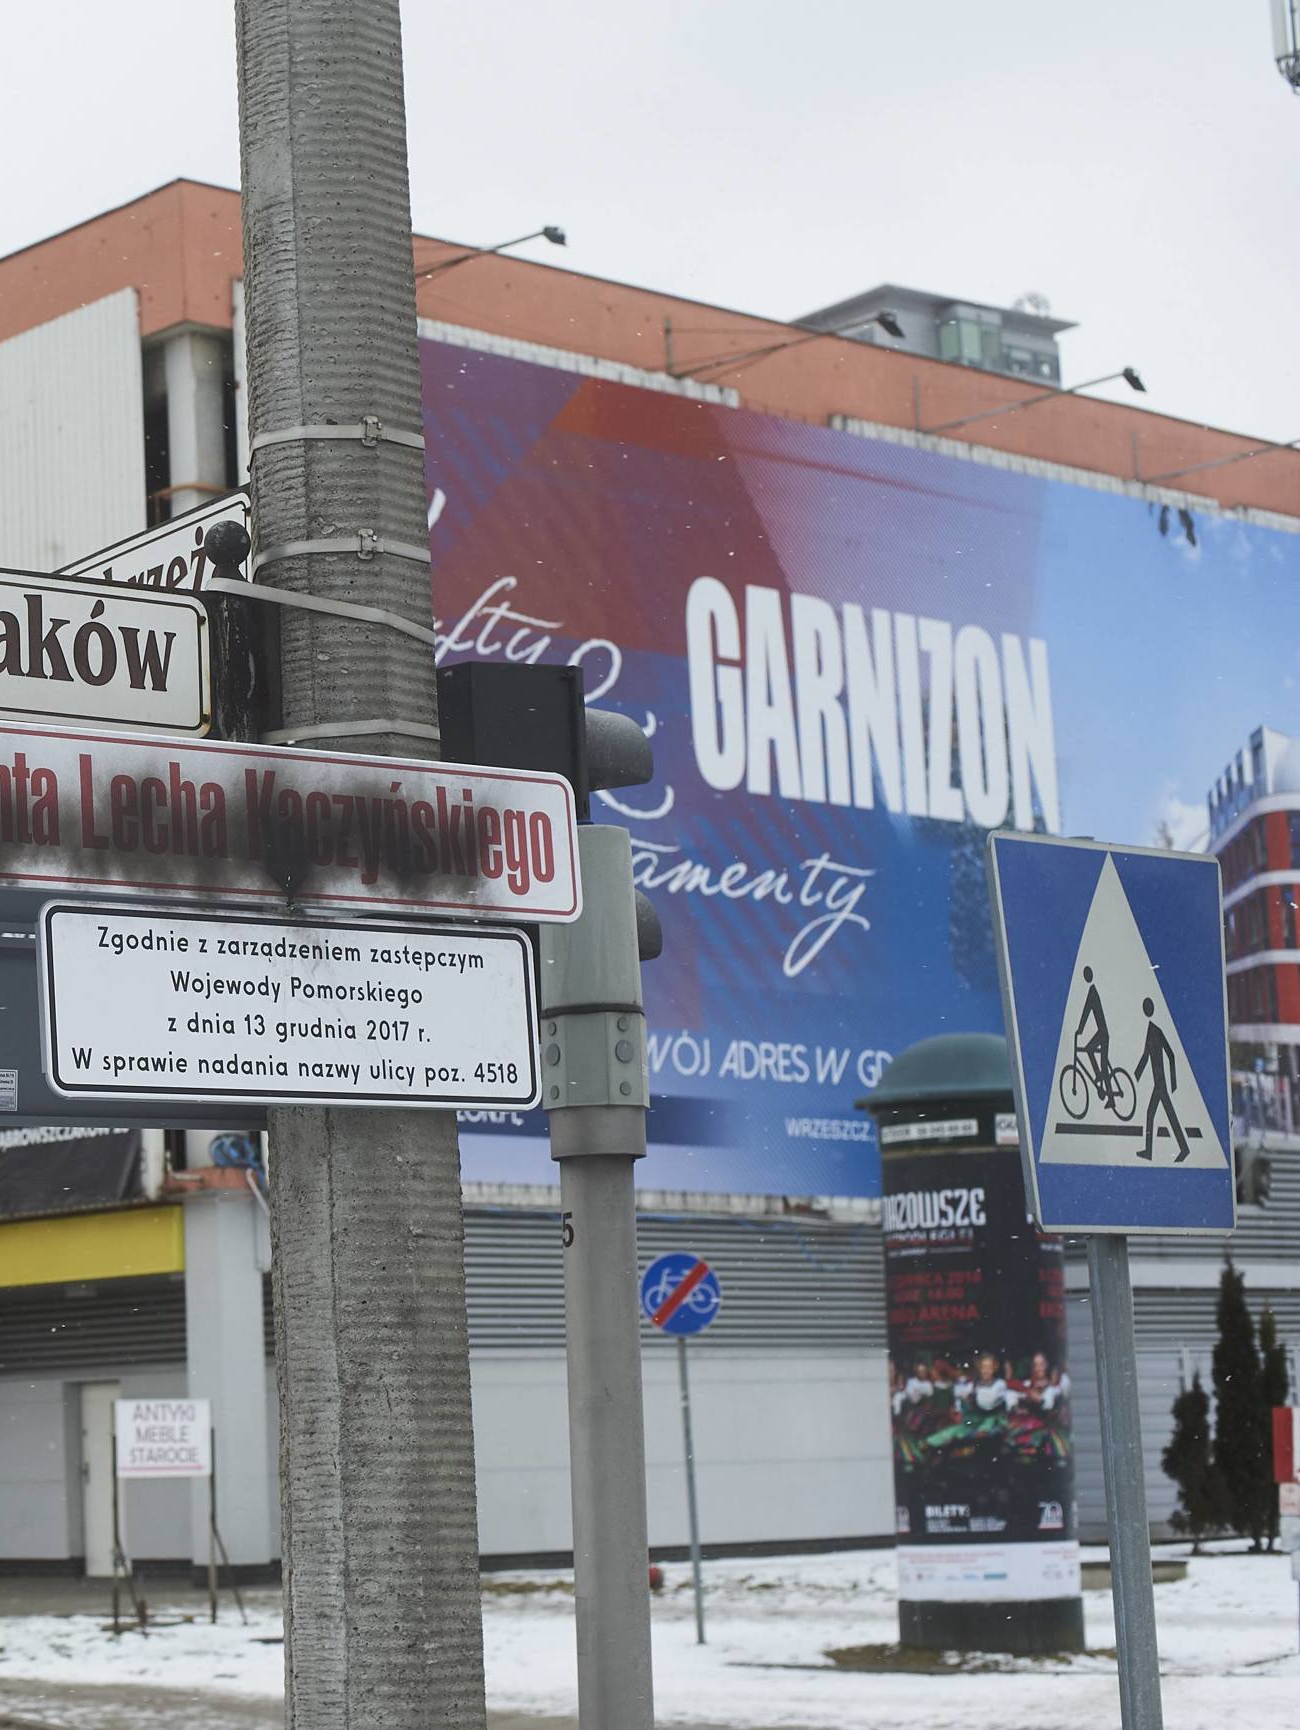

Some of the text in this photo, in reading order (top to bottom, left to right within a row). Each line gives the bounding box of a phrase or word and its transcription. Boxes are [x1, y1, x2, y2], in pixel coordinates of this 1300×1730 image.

[685, 576, 1061, 834] GARNIZON
[79, 753, 228, 859] Lecha
[245, 768, 555, 896] Kaczyńskiego
[97, 926, 484, 973] Zgodnie z zarządzeniem zastępczym
[170, 970, 423, 1009] Wojewody Pomorskiego
[167, 1012, 431, 1043] z dnia 13 grudnia 2017 r.
[71, 1047, 518, 1087] W sprawie nadania nazwy ulicy poz. 4518
[646, 1028, 712, 1077] WÓJ
[718, 1040, 811, 1084] ADRES
[814, 1045, 851, 1086] W
[135, 1425, 189, 1443] MEBLE
